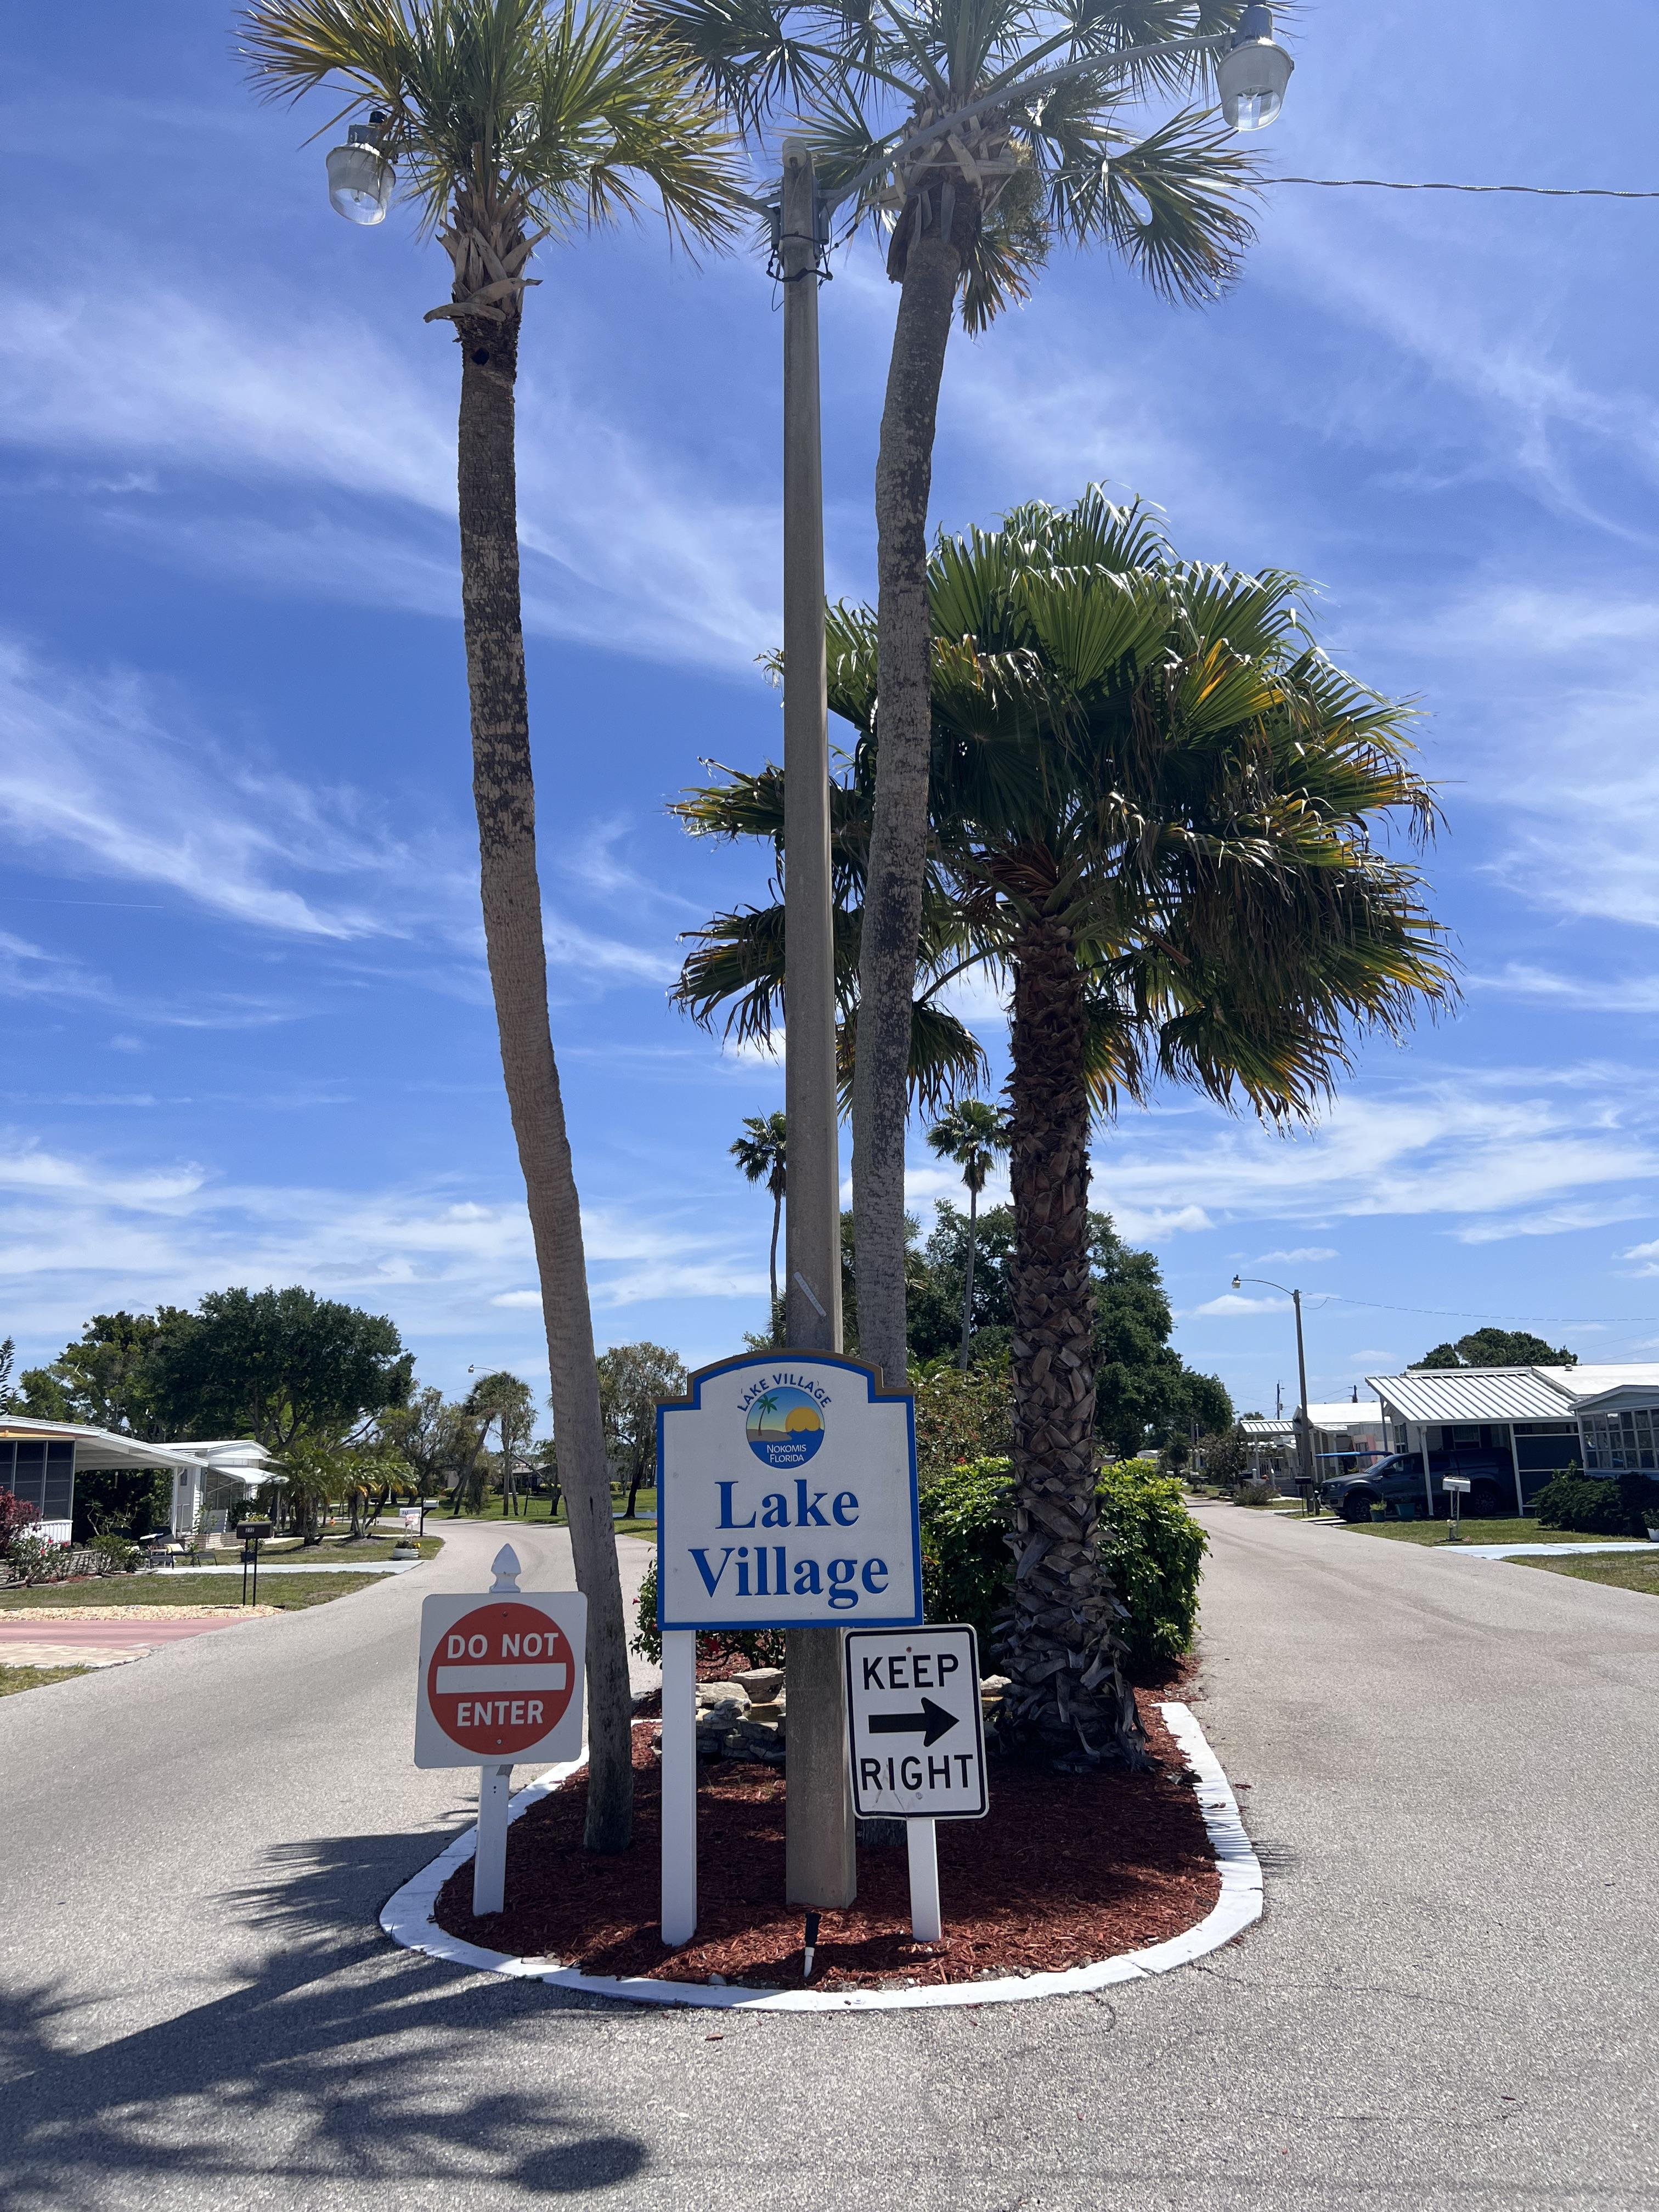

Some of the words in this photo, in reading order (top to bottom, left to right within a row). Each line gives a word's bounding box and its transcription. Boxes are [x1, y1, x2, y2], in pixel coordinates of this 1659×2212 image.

[737, 1379, 769, 1412] LAKE
[772, 1373, 832, 1408] VILLAGE
[766, 1444, 806, 1453] NOKOMIS
[770, 1454, 804, 1463] FLORIDA
[715, 1479, 859, 1528] Lake
[688, 1546, 888, 1609] Village
[447, 1634, 488, 1658] DO
[501, 1632, 558, 1657] NOT
[862, 1654, 959, 1690] KEEP
[457, 1700, 544, 1726] ENTER
[860, 1754, 973, 1791] RIGHT
